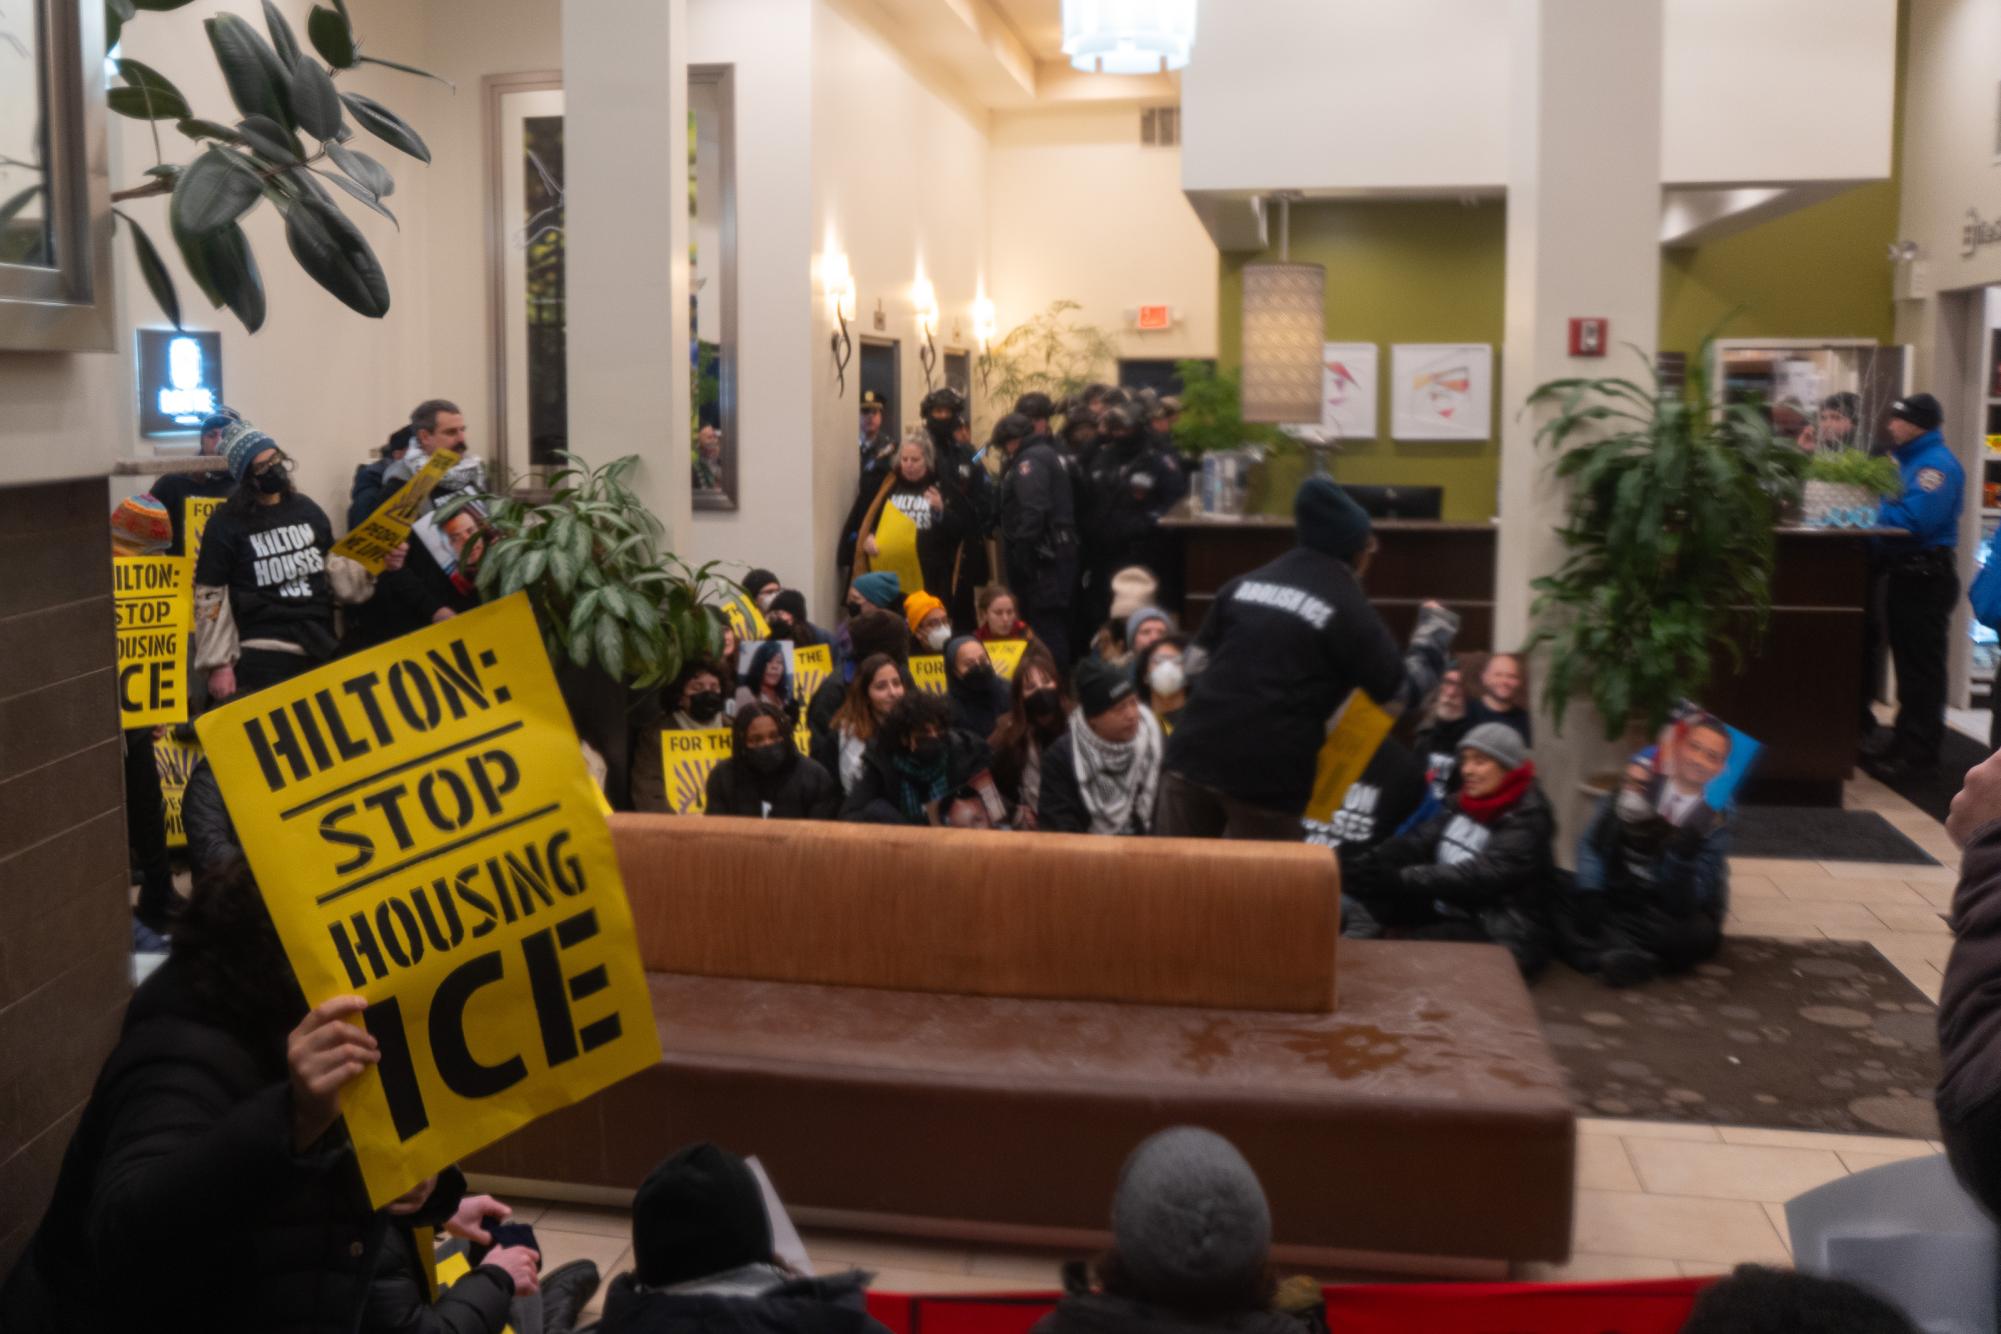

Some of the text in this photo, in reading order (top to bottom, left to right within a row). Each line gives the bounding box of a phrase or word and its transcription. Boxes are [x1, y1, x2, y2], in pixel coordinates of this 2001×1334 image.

[193, 503, 214, 517] FO
[249, 523, 315, 558] HILTON
[113, 563, 181, 592] ILTON:
[253, 546, 324, 587] HOUSES
[118, 633, 178, 661] OUSING
[797, 650, 824, 664] THE
[915, 660, 945, 674] FOR
[120, 660, 176, 713] CE
[243, 639, 512, 793] HILTON:
[670, 734, 733, 752] FOR TH
[319, 749, 521, 876] STOP
[328, 828, 588, 990] HOUSING
[362, 906, 623, 1144] ICE
